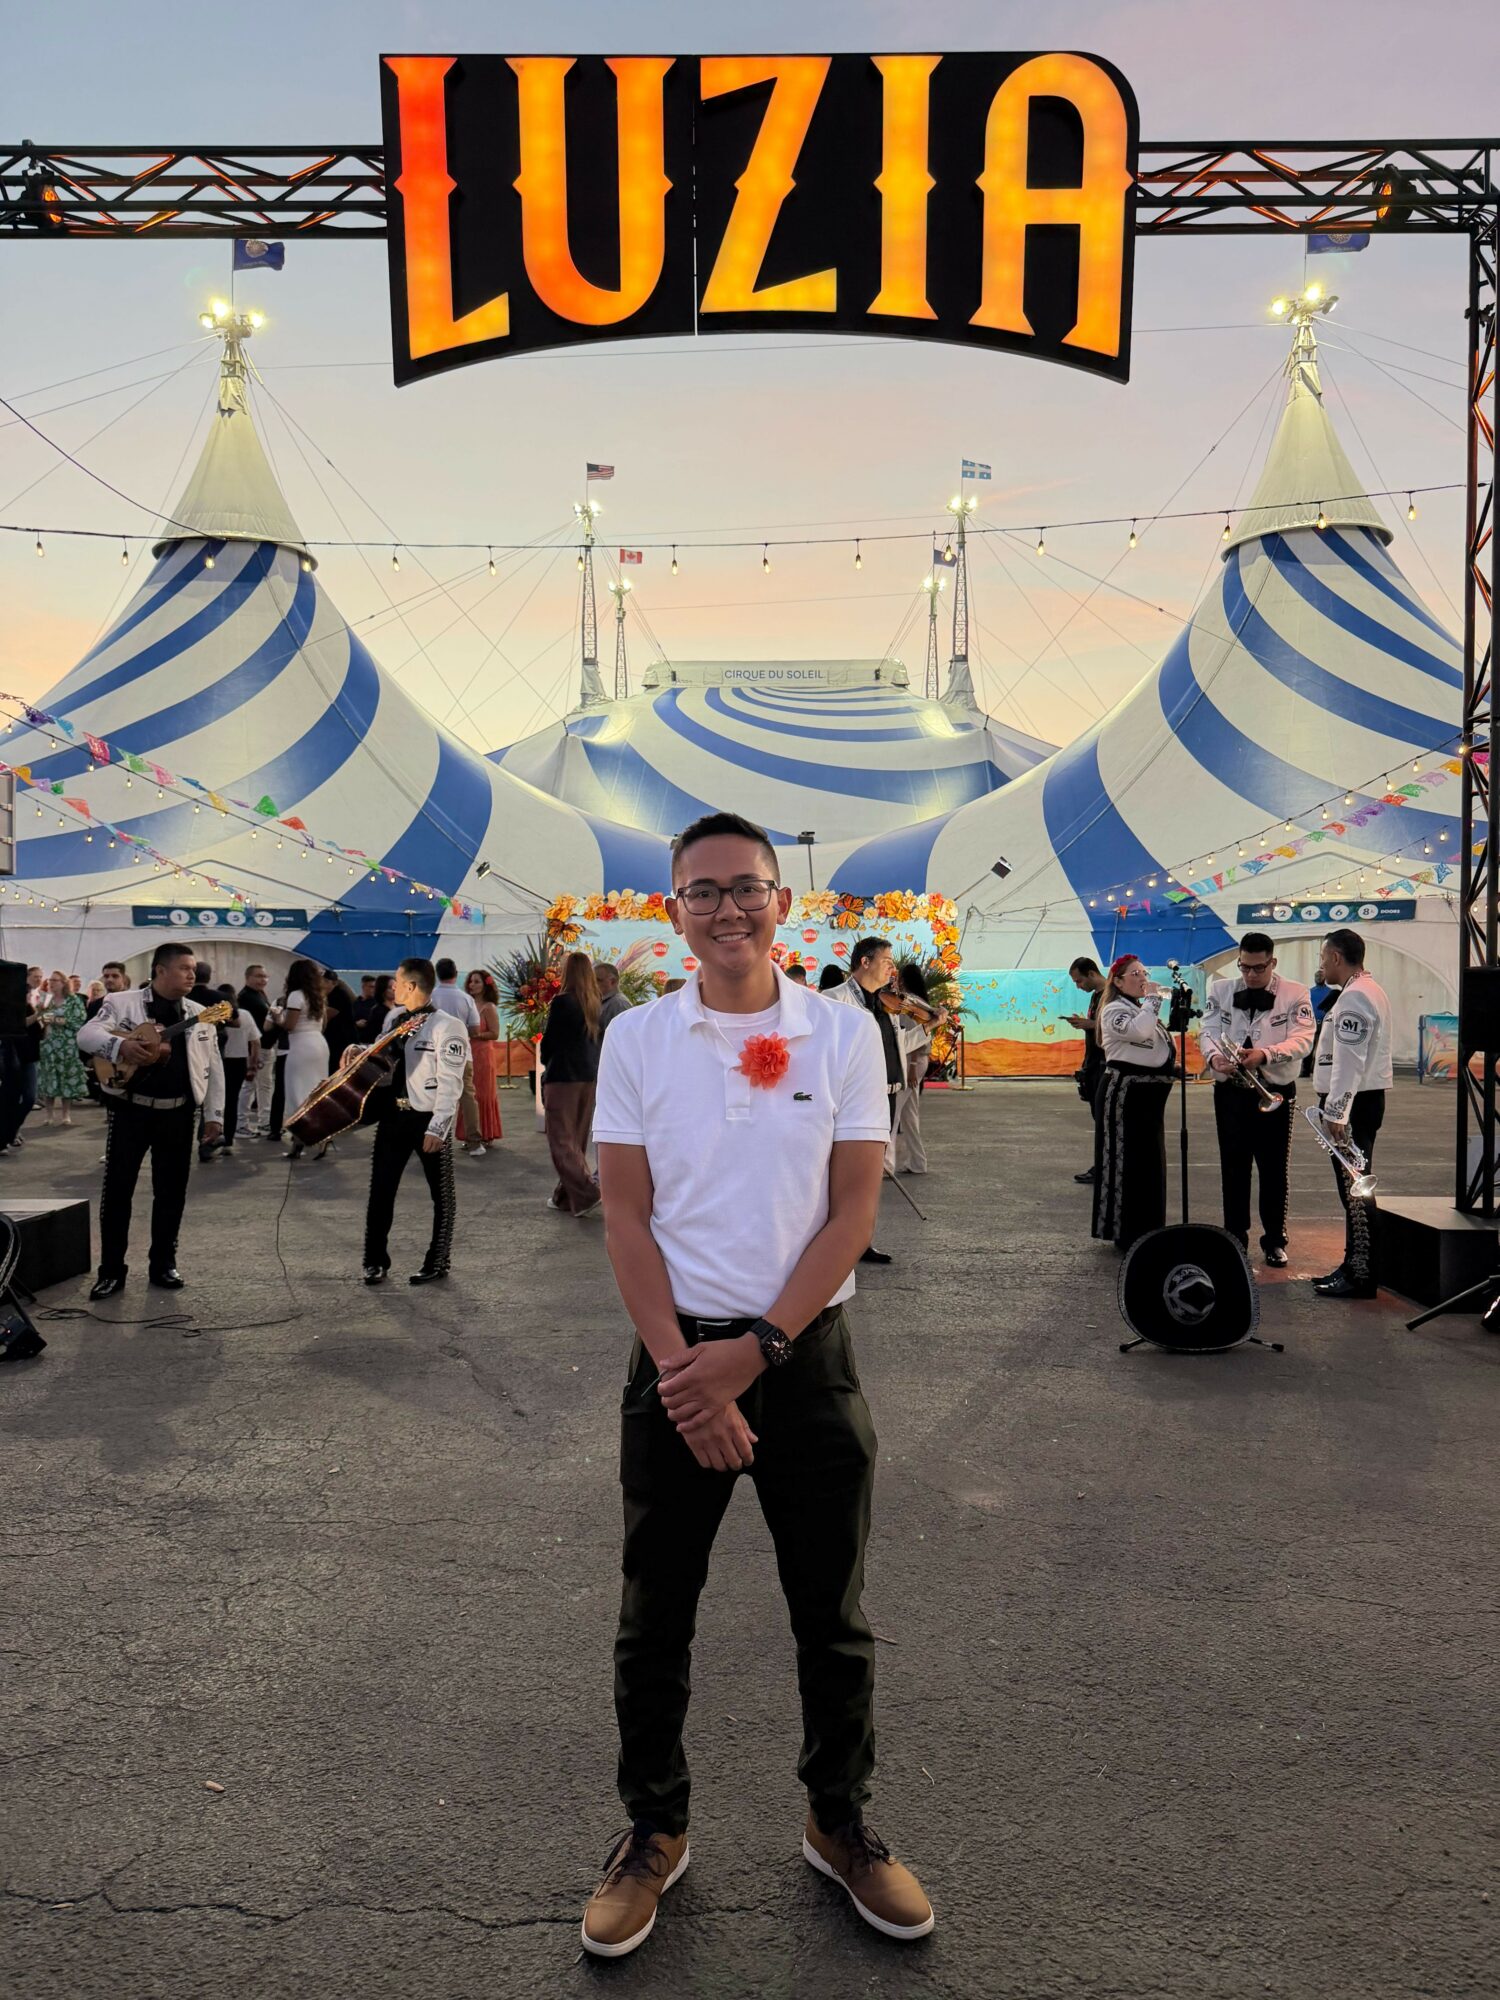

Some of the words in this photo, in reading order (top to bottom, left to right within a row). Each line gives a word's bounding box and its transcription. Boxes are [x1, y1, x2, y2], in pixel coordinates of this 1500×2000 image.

[382, 53, 1133, 360] LUZIA
[724, 670, 765, 681] CIRQUE
[768, 670, 784, 679] DU
[786, 670, 824, 679] SOLEIL
[203, 913, 210, 922] 3
[232, 914, 240, 922] 5
[258, 914, 265, 922] 7
[1335, 908, 1342, 916] 6
[1362, 907, 1369, 916] 8
[1341, 1019, 1359, 1032] SM
[448, 1043, 462, 1056] SM
